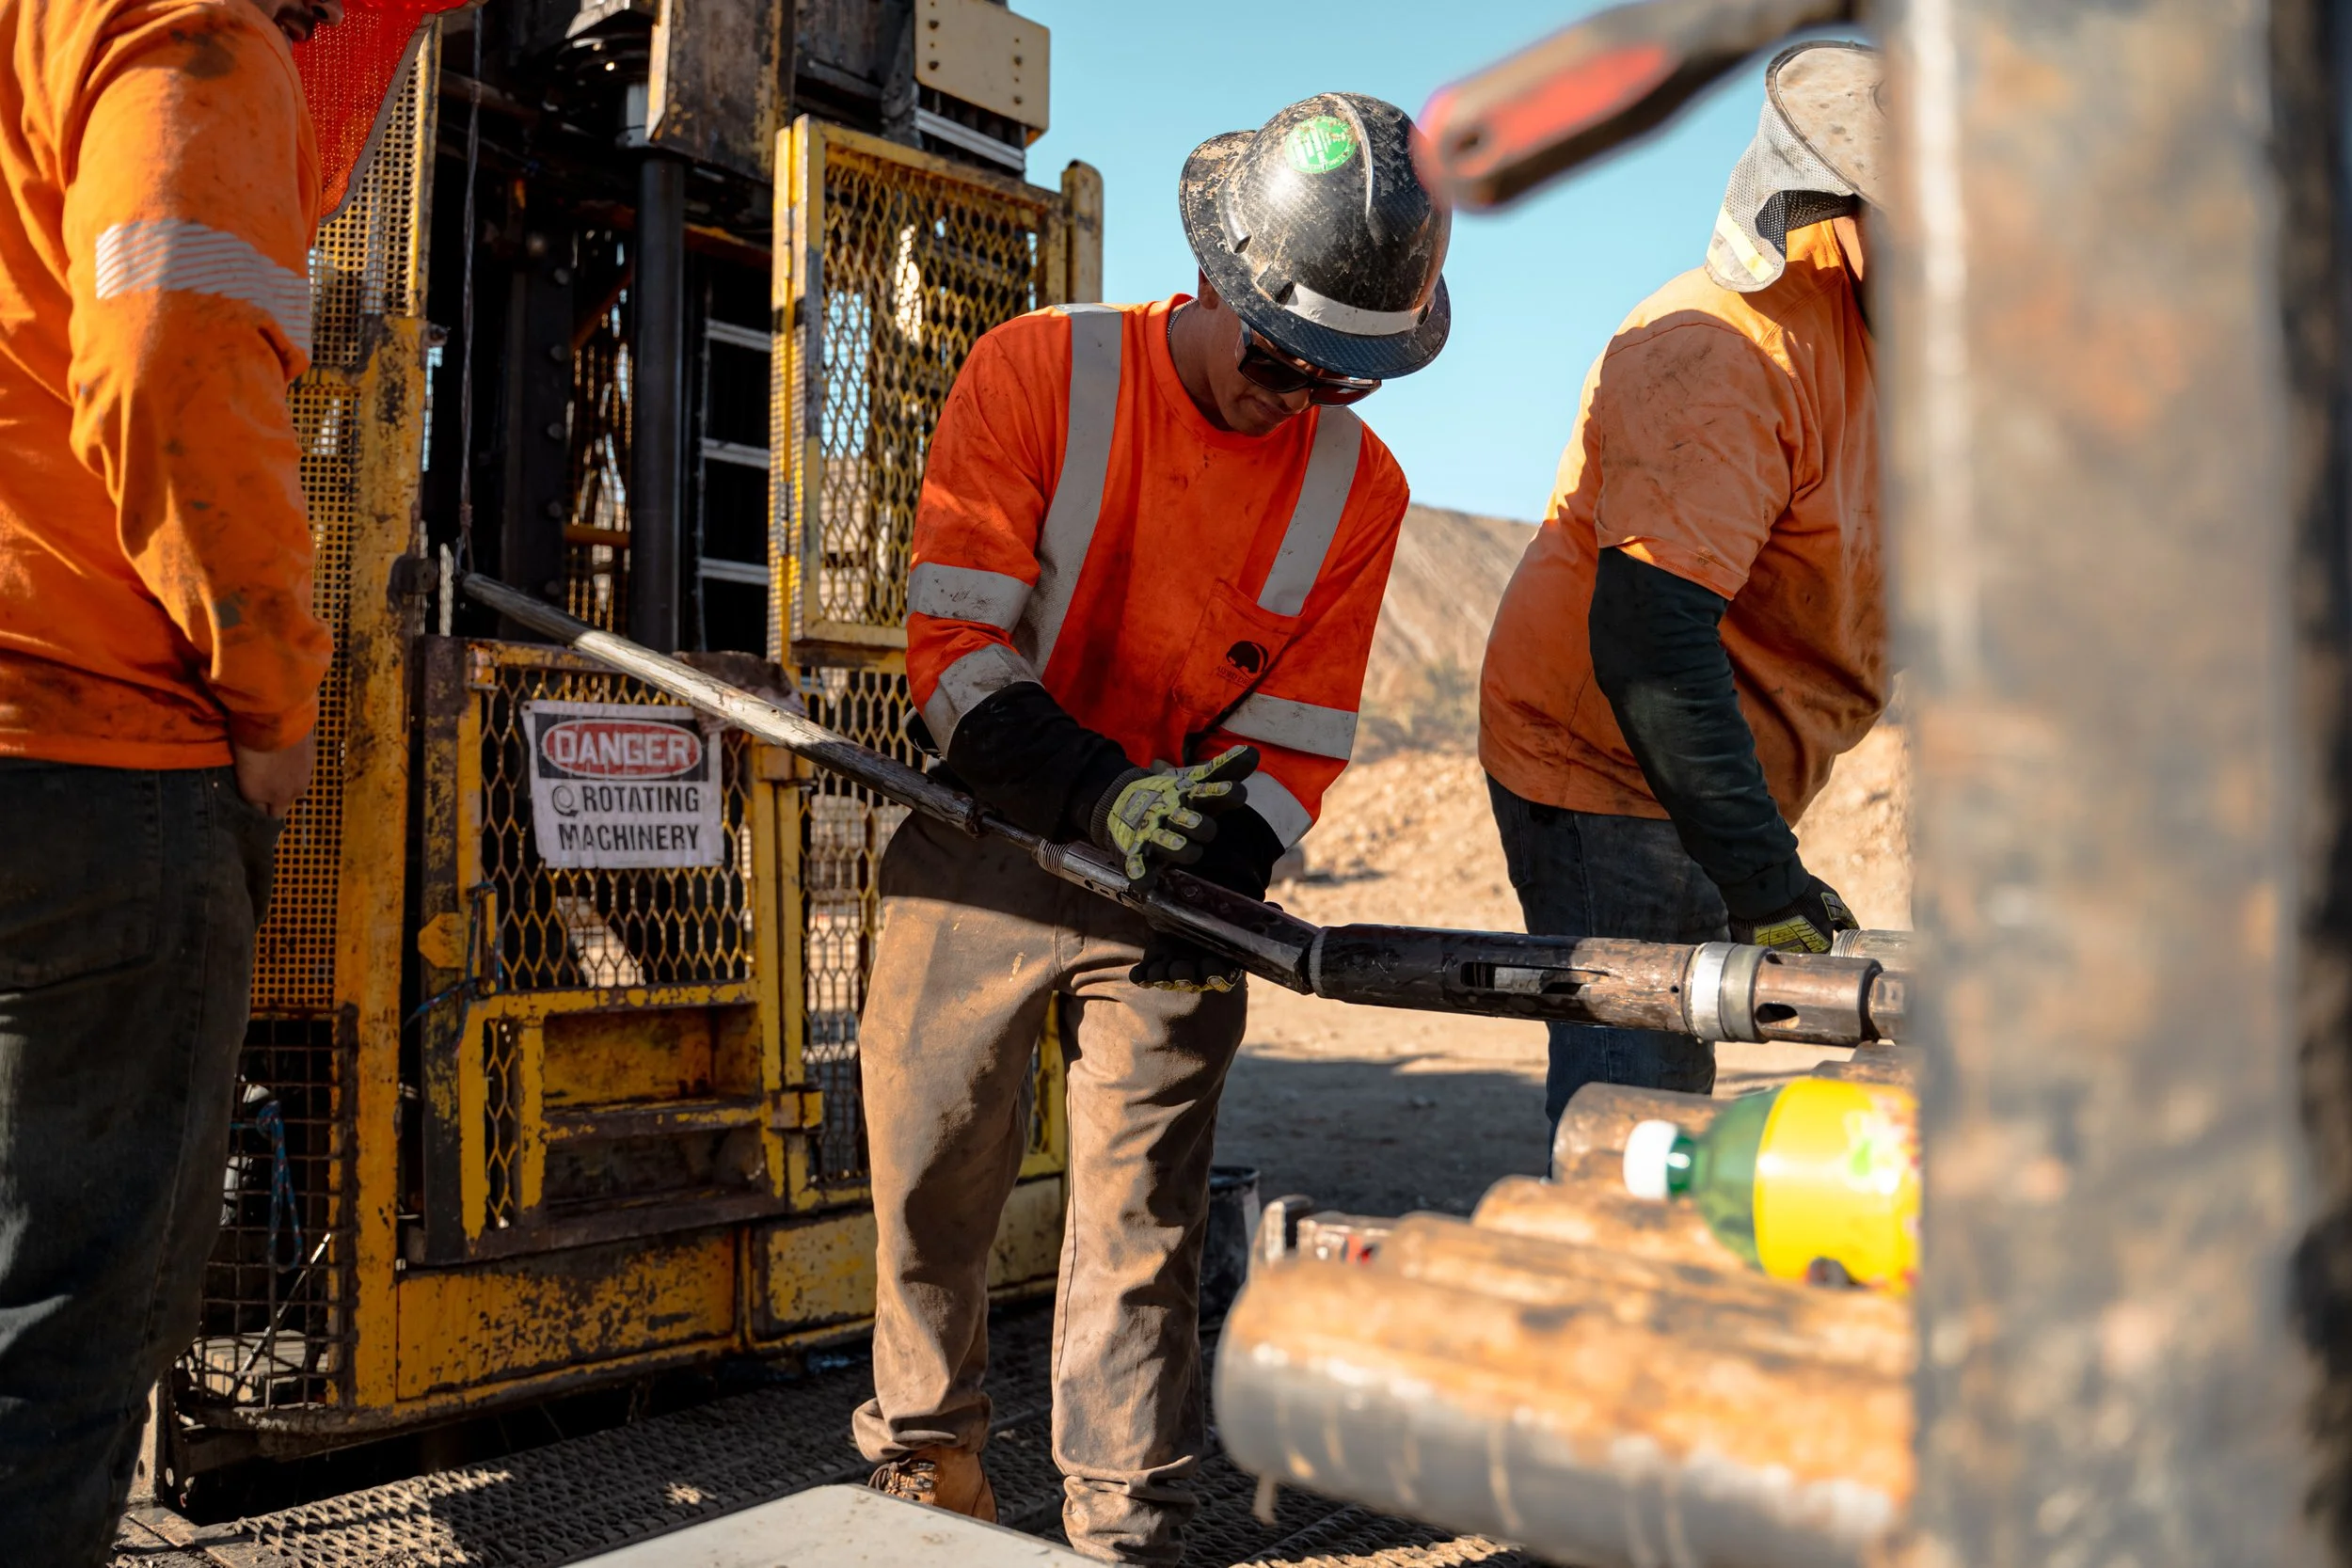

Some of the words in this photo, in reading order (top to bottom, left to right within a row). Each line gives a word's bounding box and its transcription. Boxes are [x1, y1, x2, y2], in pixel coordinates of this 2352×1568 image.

[552, 729, 691, 767] DANGER
[581, 784, 700, 813] ROTATING
[558, 823, 700, 851] MACHINERY
